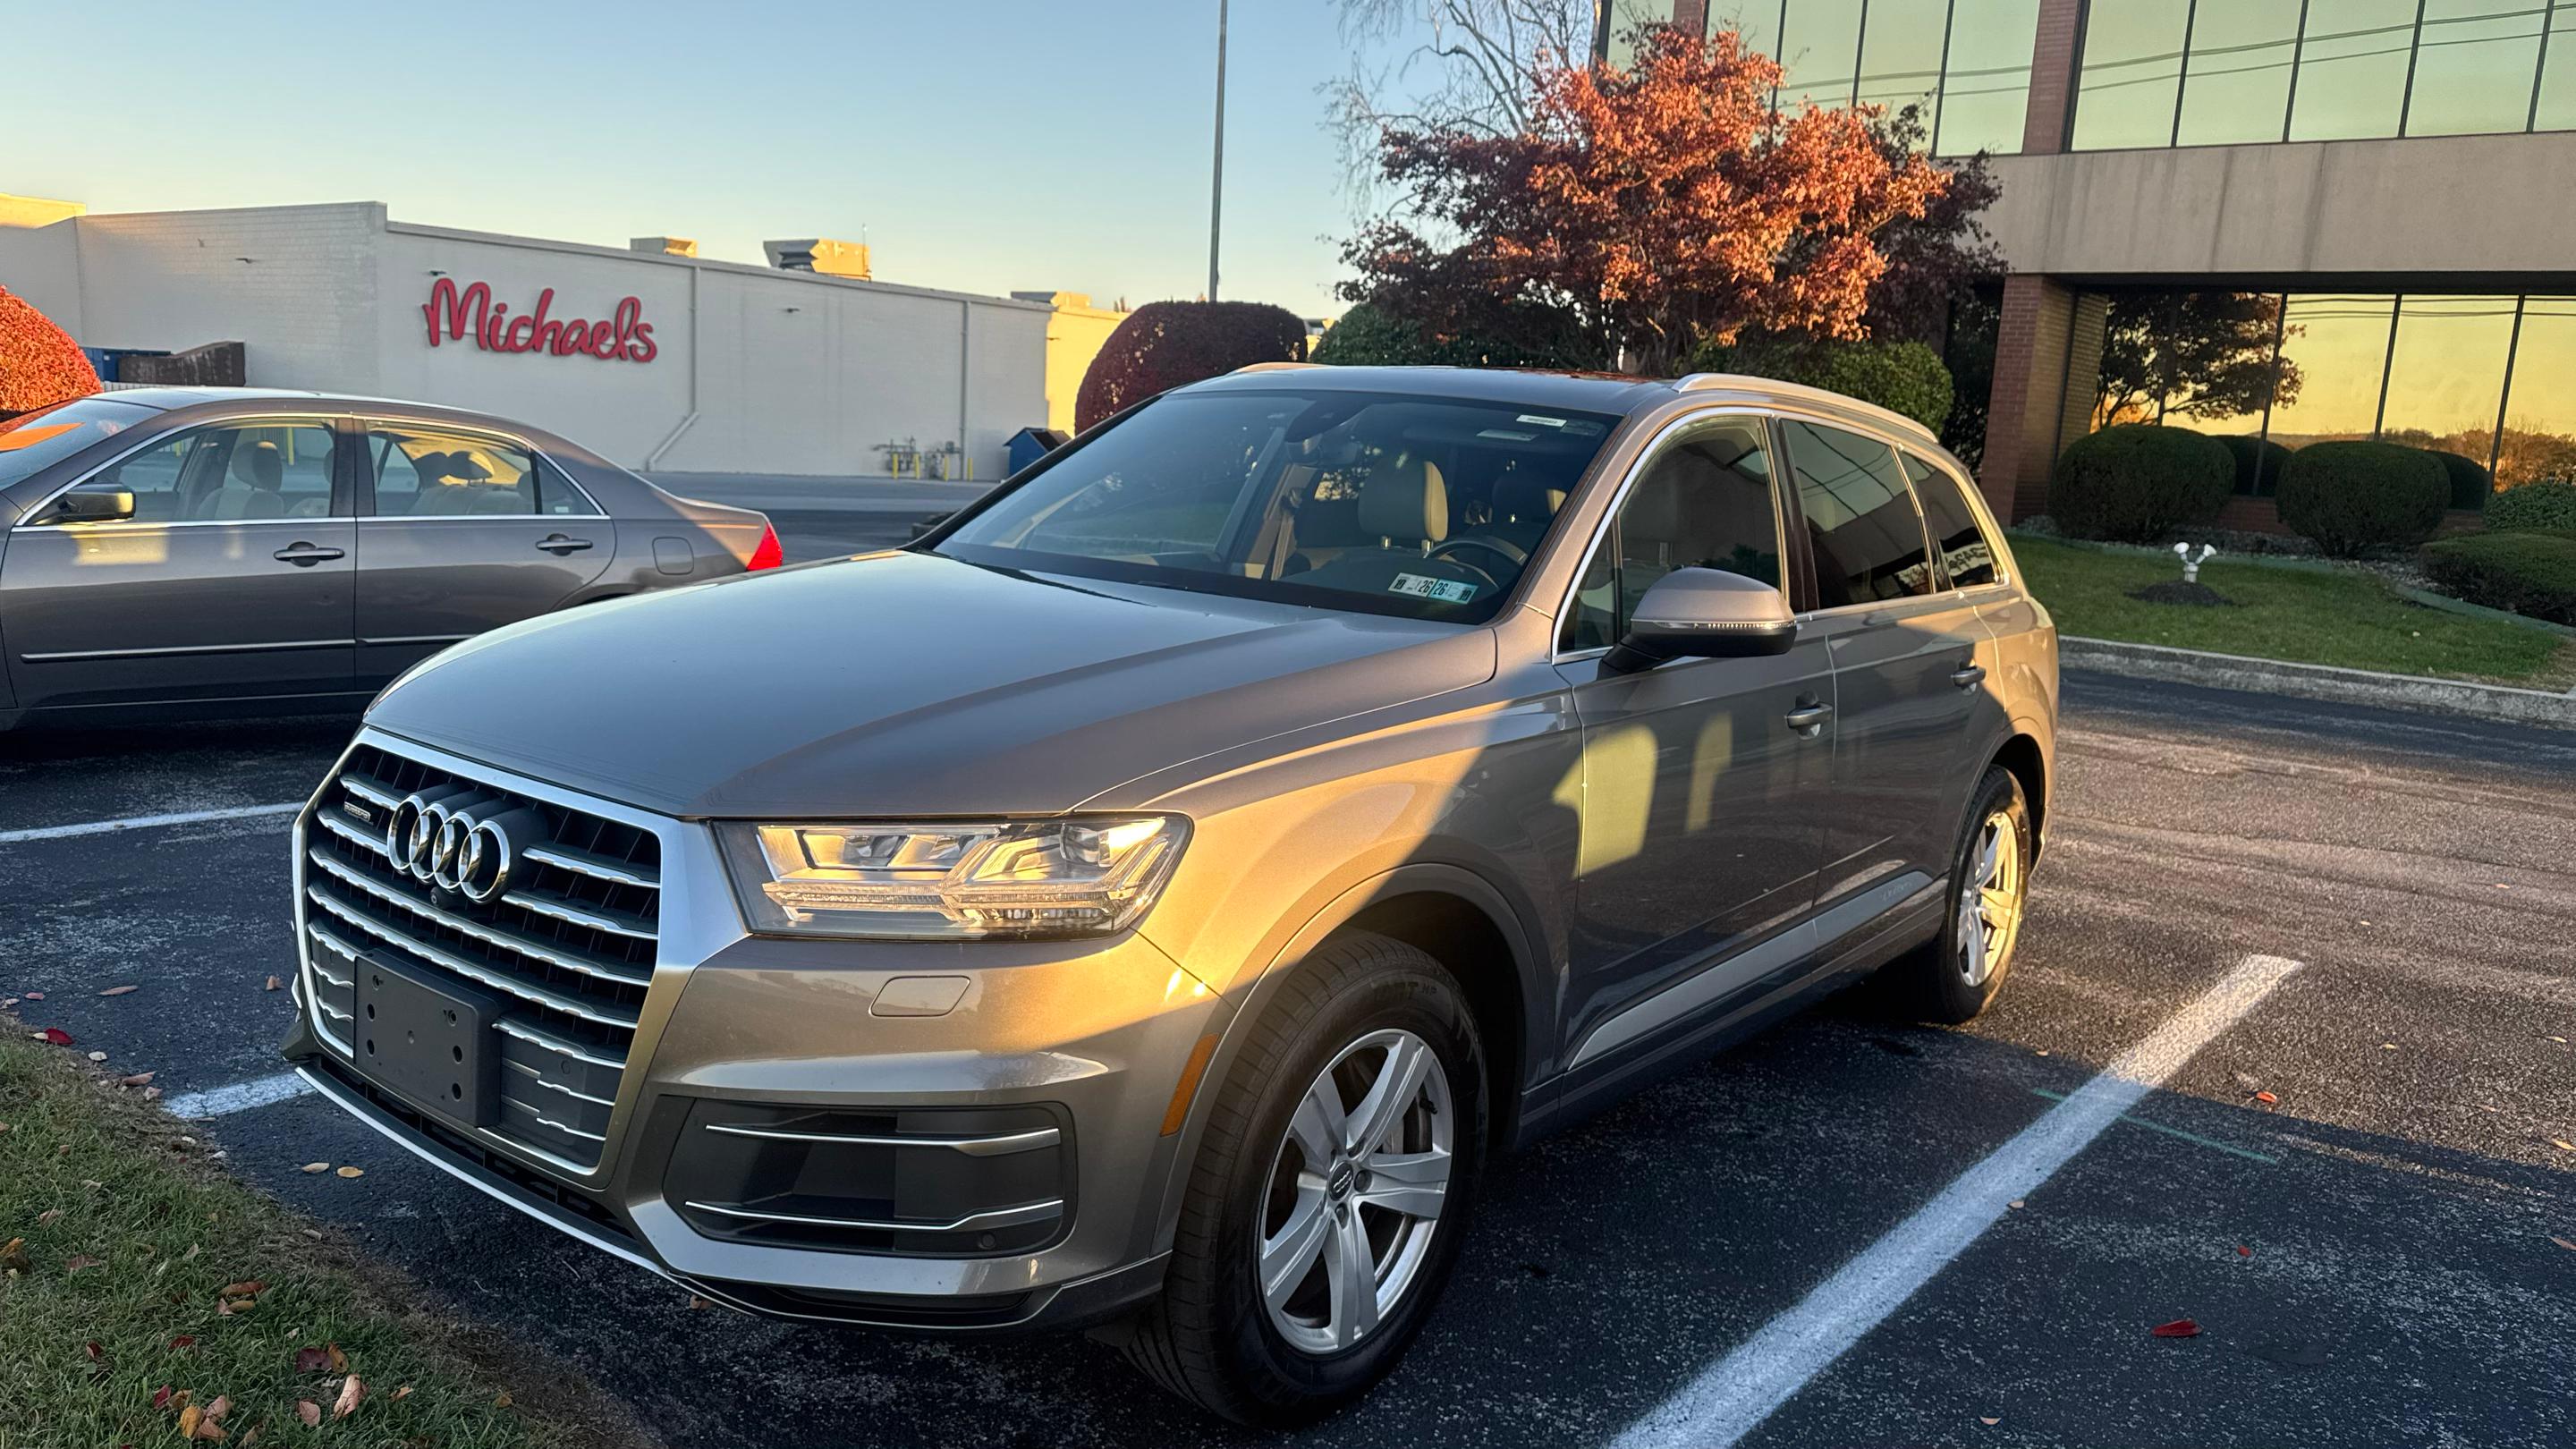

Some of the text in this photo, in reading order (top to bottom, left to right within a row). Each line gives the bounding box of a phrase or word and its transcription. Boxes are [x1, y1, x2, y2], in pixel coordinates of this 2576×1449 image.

[422, 277, 657, 362] Michaels
[1419, 580, 1433, 592] 26
[1434, 582, 1448, 596] 26
